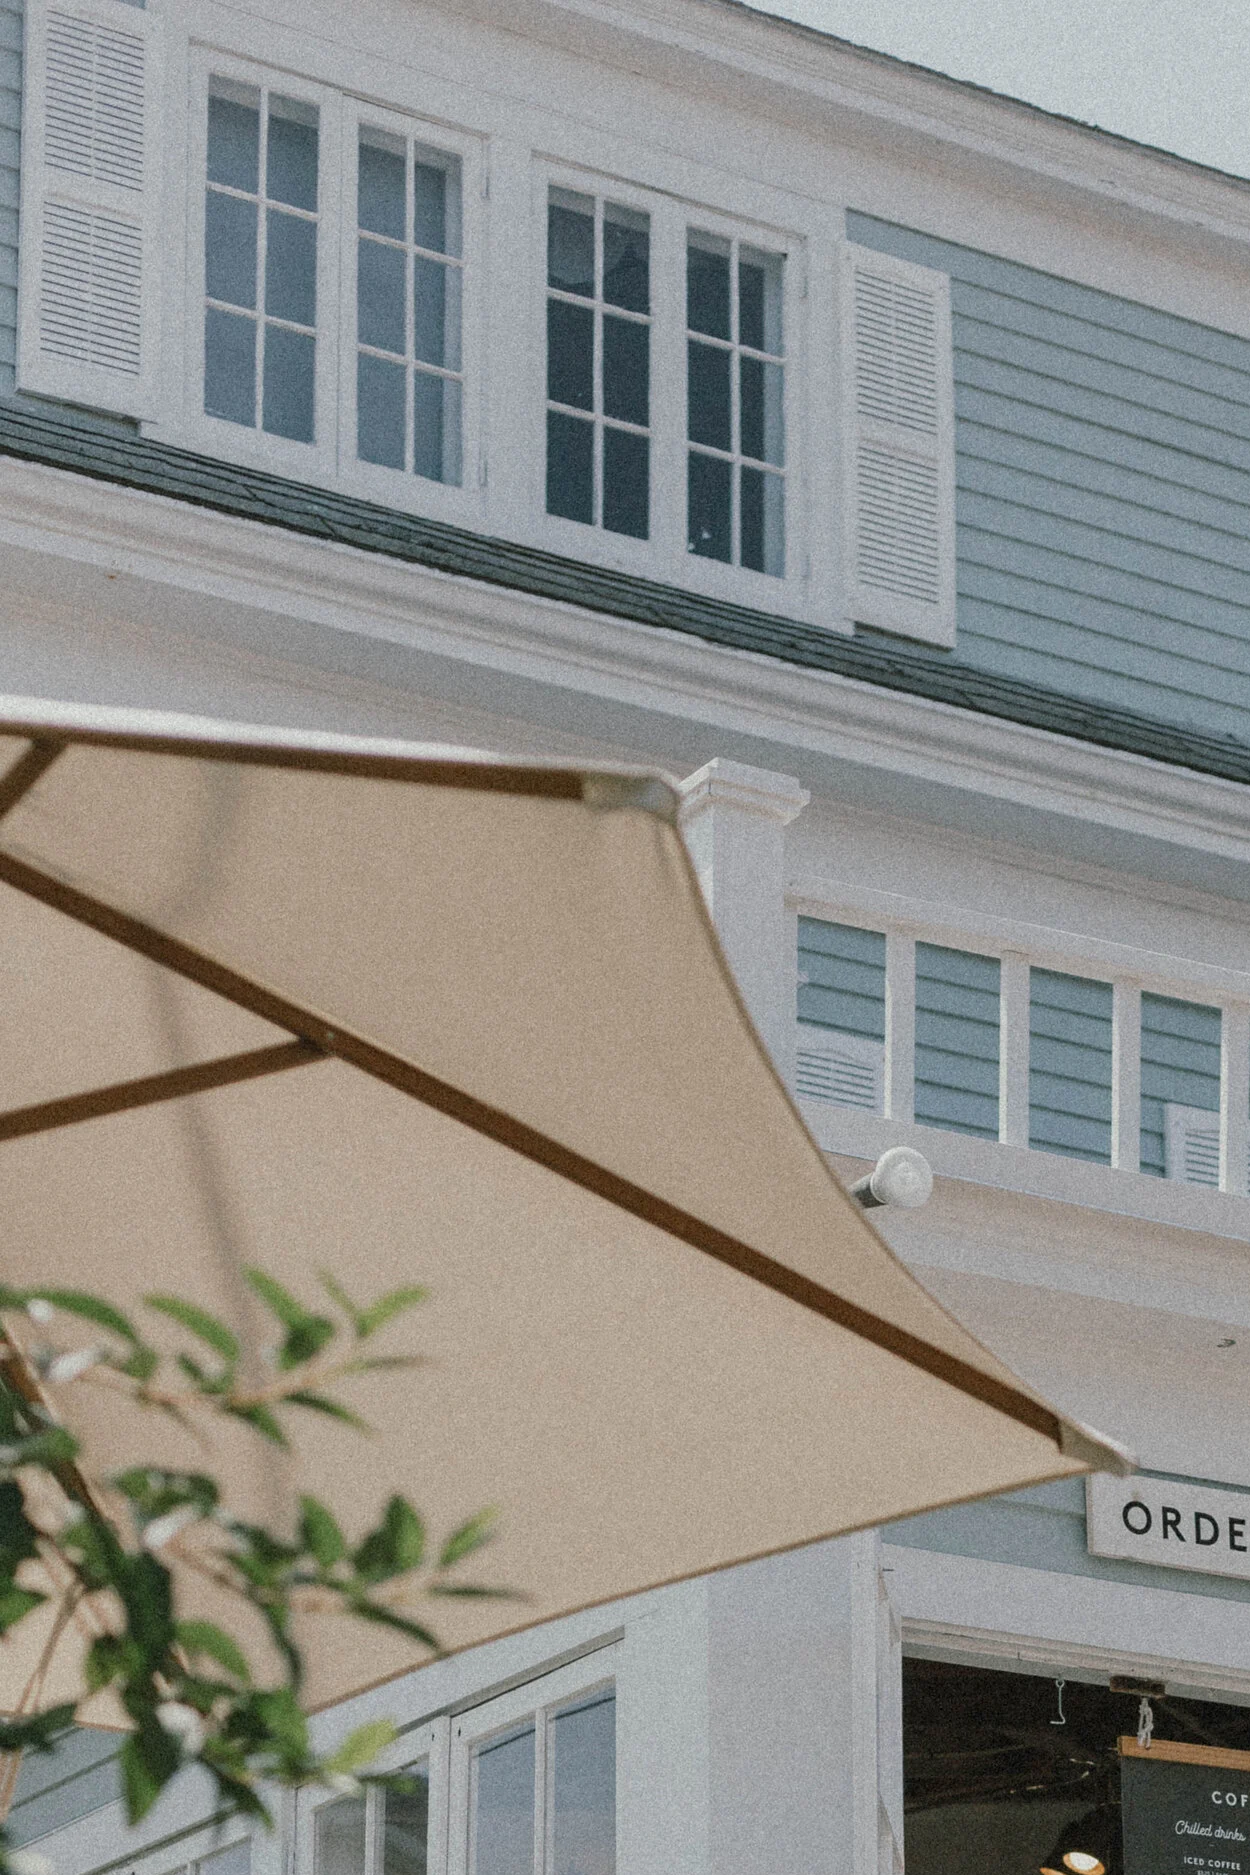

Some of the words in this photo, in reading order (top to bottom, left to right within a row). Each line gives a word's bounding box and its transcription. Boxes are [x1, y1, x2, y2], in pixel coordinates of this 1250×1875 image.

[1175, 1820, 1212, 1837] Chilled
[1214, 1826, 1246, 1841] drinks
[1183, 1856, 1205, 1866] ICED
[1208, 1859, 1241, 1871] COFFEE
